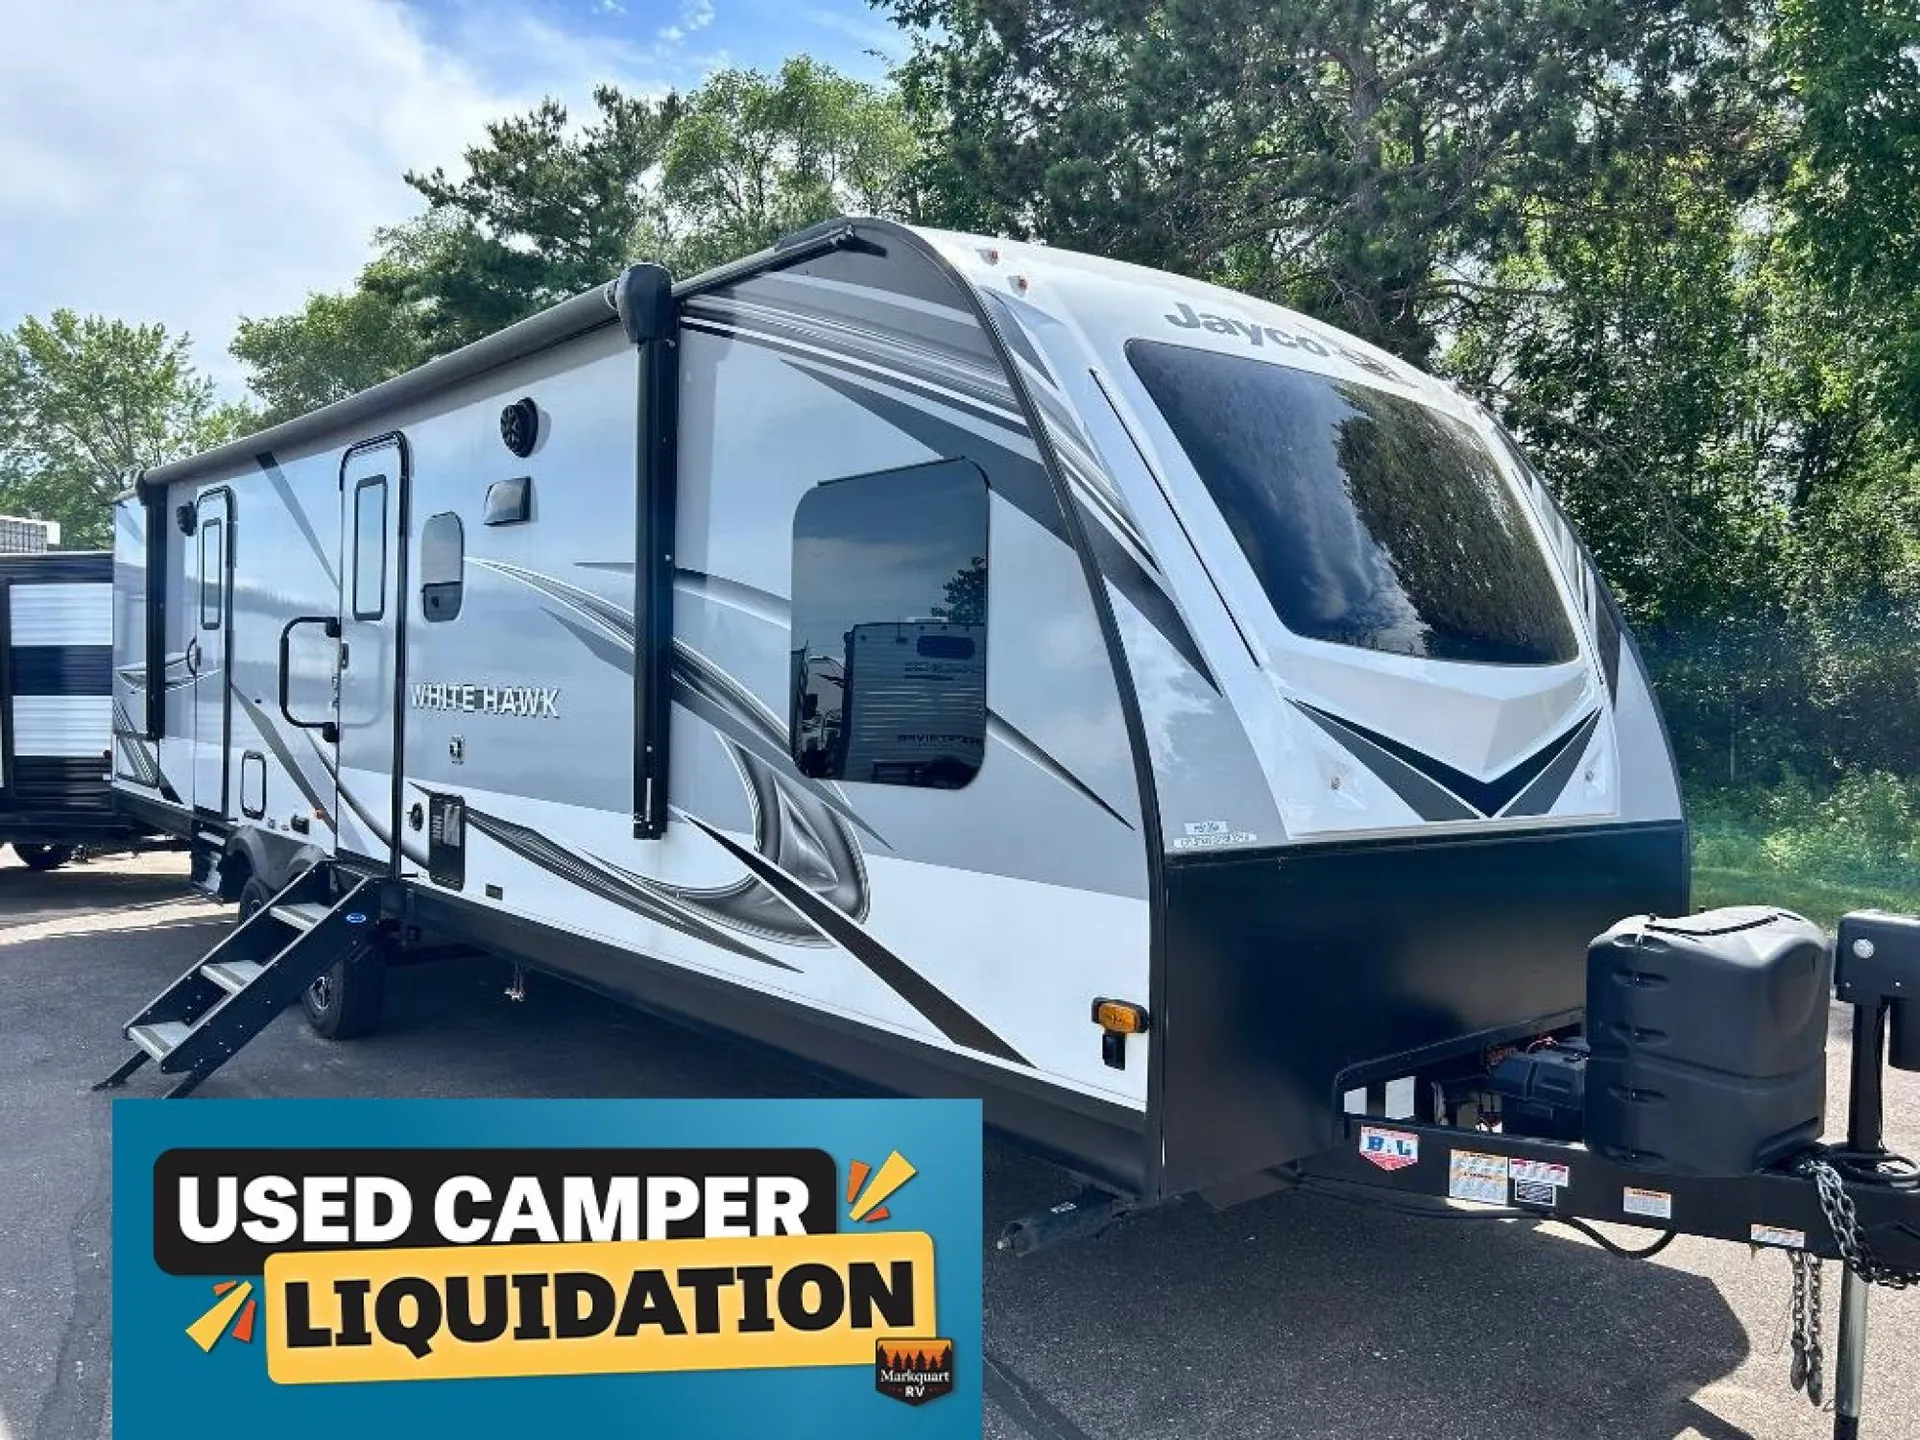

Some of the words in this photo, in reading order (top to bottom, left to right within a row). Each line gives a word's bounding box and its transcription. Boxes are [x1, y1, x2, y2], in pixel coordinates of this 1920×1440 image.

[1164, 302, 1330, 357] Jayco
[410, 683, 476, 713] WHITE
[483, 685, 562, 719] HAWK
[1367, 1136, 1412, 1155] BL
